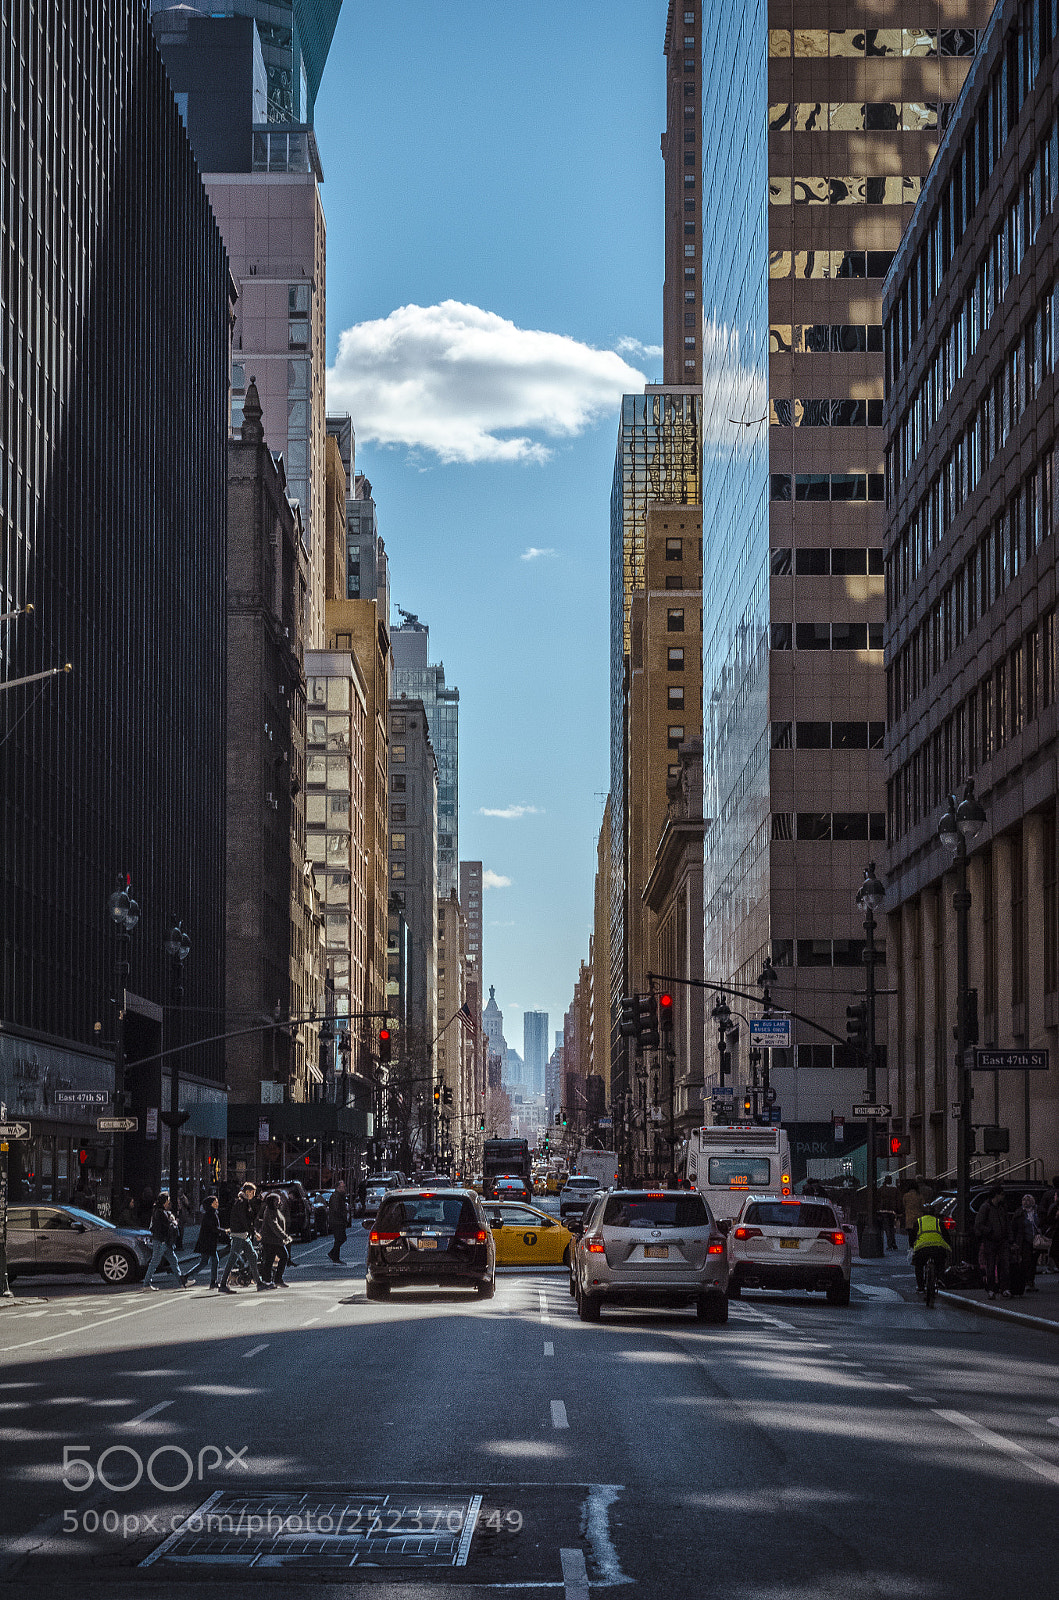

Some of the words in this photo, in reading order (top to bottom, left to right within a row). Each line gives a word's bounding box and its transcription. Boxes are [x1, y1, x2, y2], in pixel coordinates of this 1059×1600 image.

[982, 1055, 1004, 1065] East
[1006, 1055, 1029, 1065] 47th
[1031, 1055, 1042, 1065] St
[58, 1093, 75, 1102] East
[77, 1093, 94, 1102] 47th
[95, 1093, 105, 1102] St
